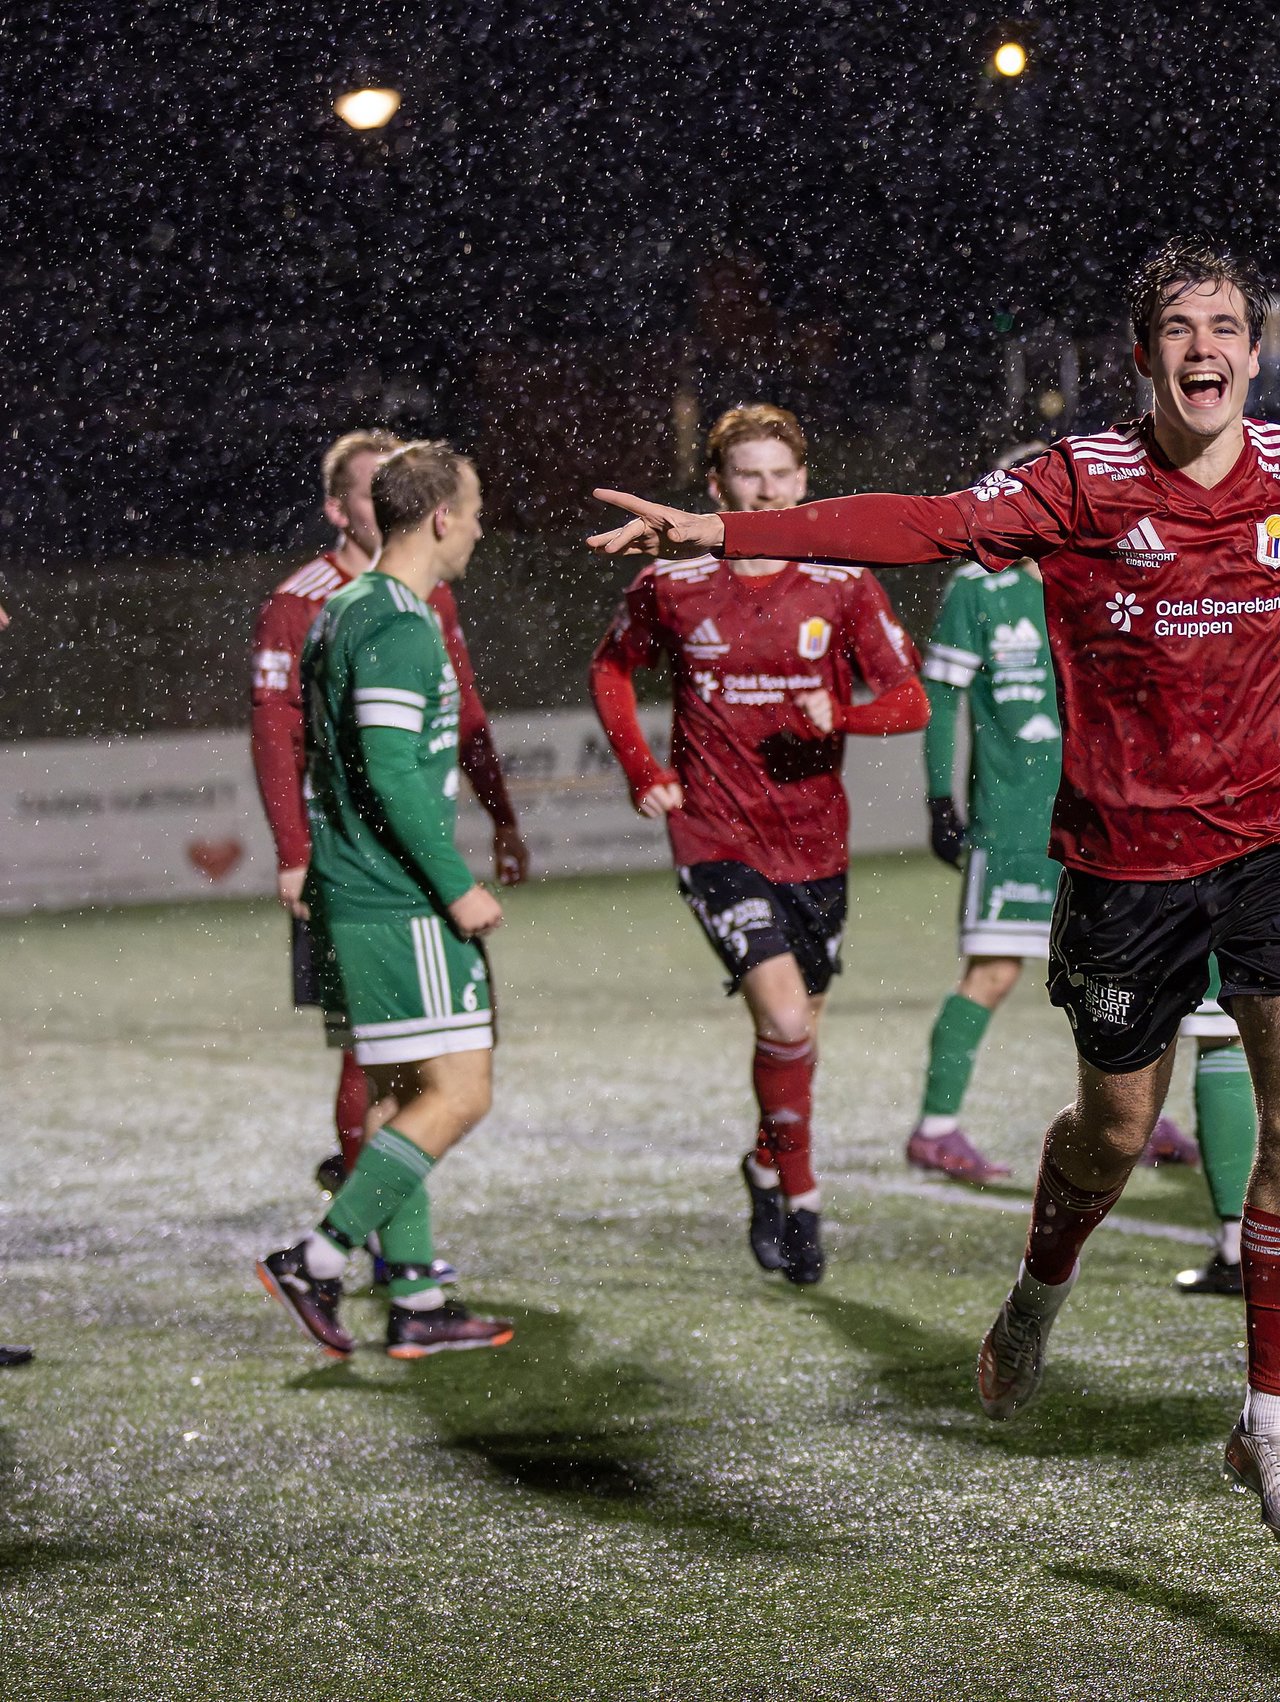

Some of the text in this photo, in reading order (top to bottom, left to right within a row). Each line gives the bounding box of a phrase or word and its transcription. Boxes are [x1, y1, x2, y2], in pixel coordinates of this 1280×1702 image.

[1155, 599, 1199, 617] Odal
[1154, 619, 1234, 639] Gruppen
[463, 982, 478, 1012] 6
[1085, 989, 1131, 1017] SPORT
[1086, 976, 1130, 1005] INTER
